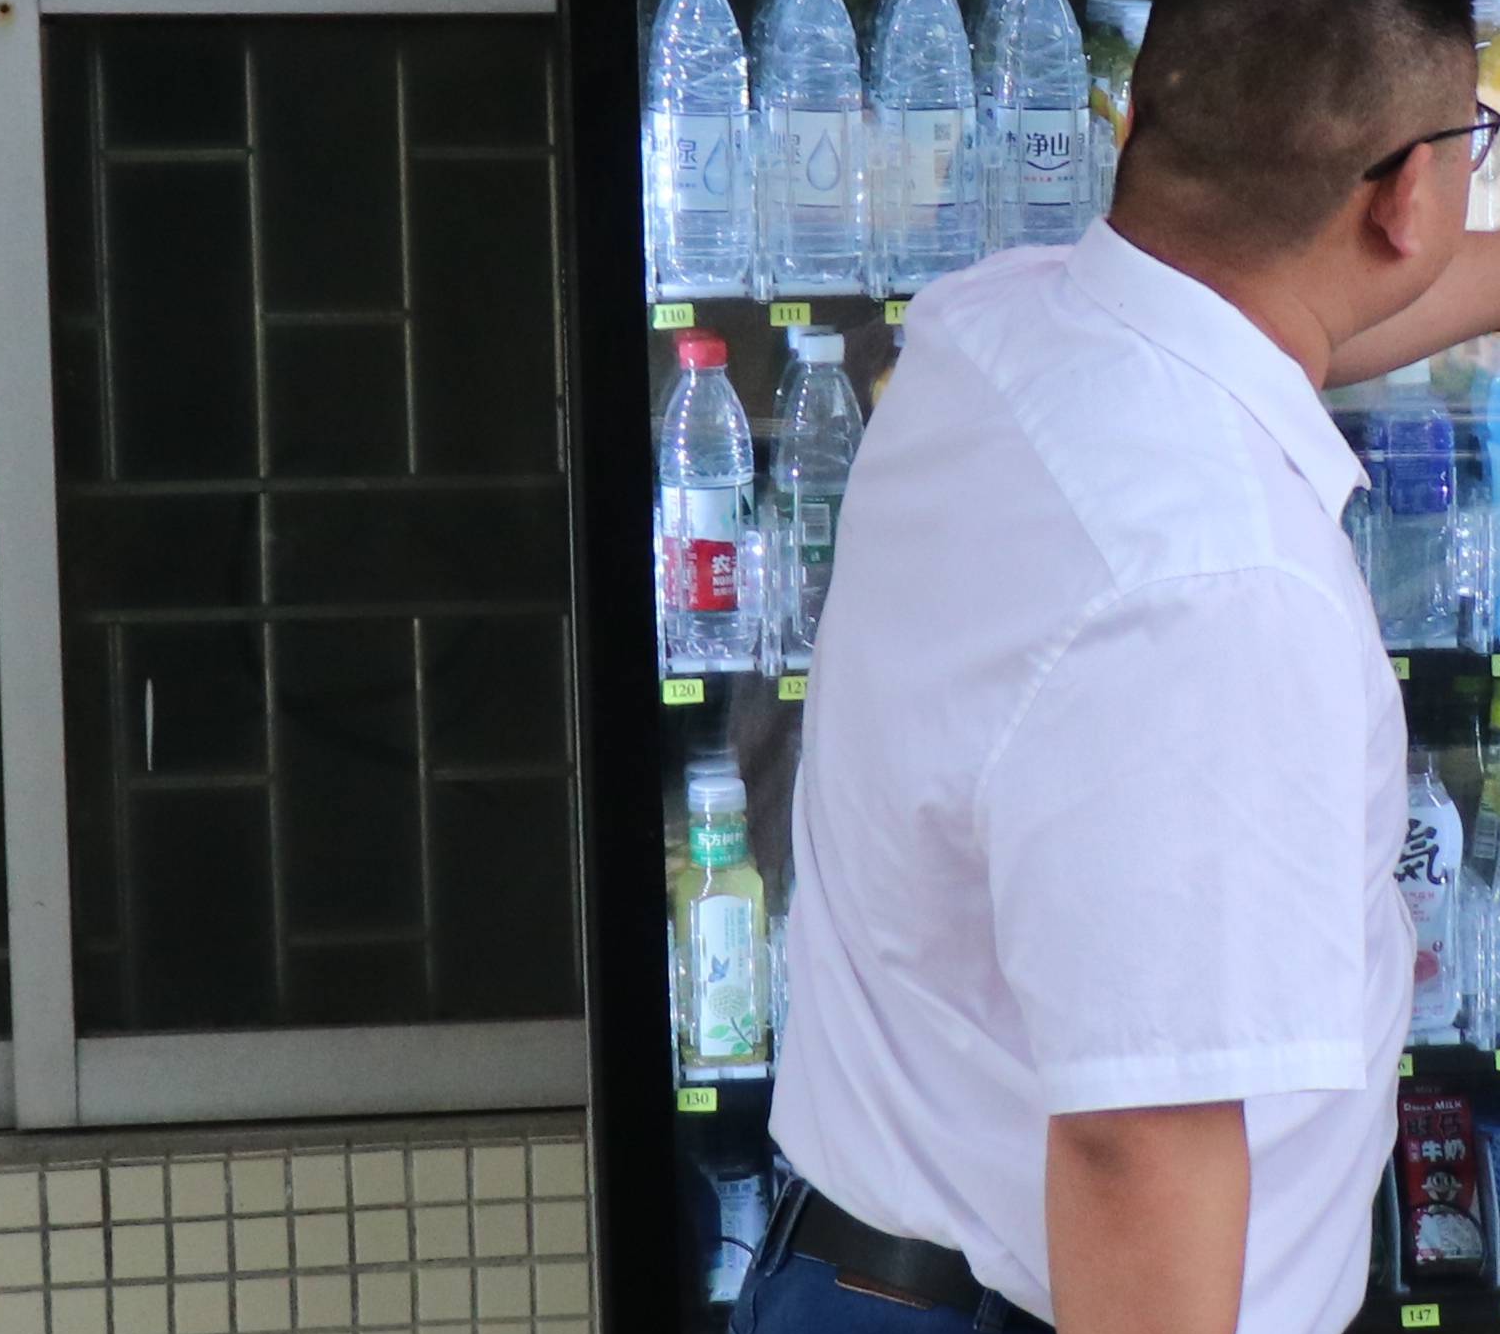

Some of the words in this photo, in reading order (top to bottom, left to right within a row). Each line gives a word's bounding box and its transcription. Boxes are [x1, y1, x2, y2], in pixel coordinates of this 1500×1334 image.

[659, 309, 686, 323] 110
[778, 307, 802, 321] 111
[671, 684, 697, 697] 120
[684, 1092, 710, 1105] 130
[1420, 1139, 1467, 1163] 牛奶
[1409, 1309, 1431, 1322] 147
